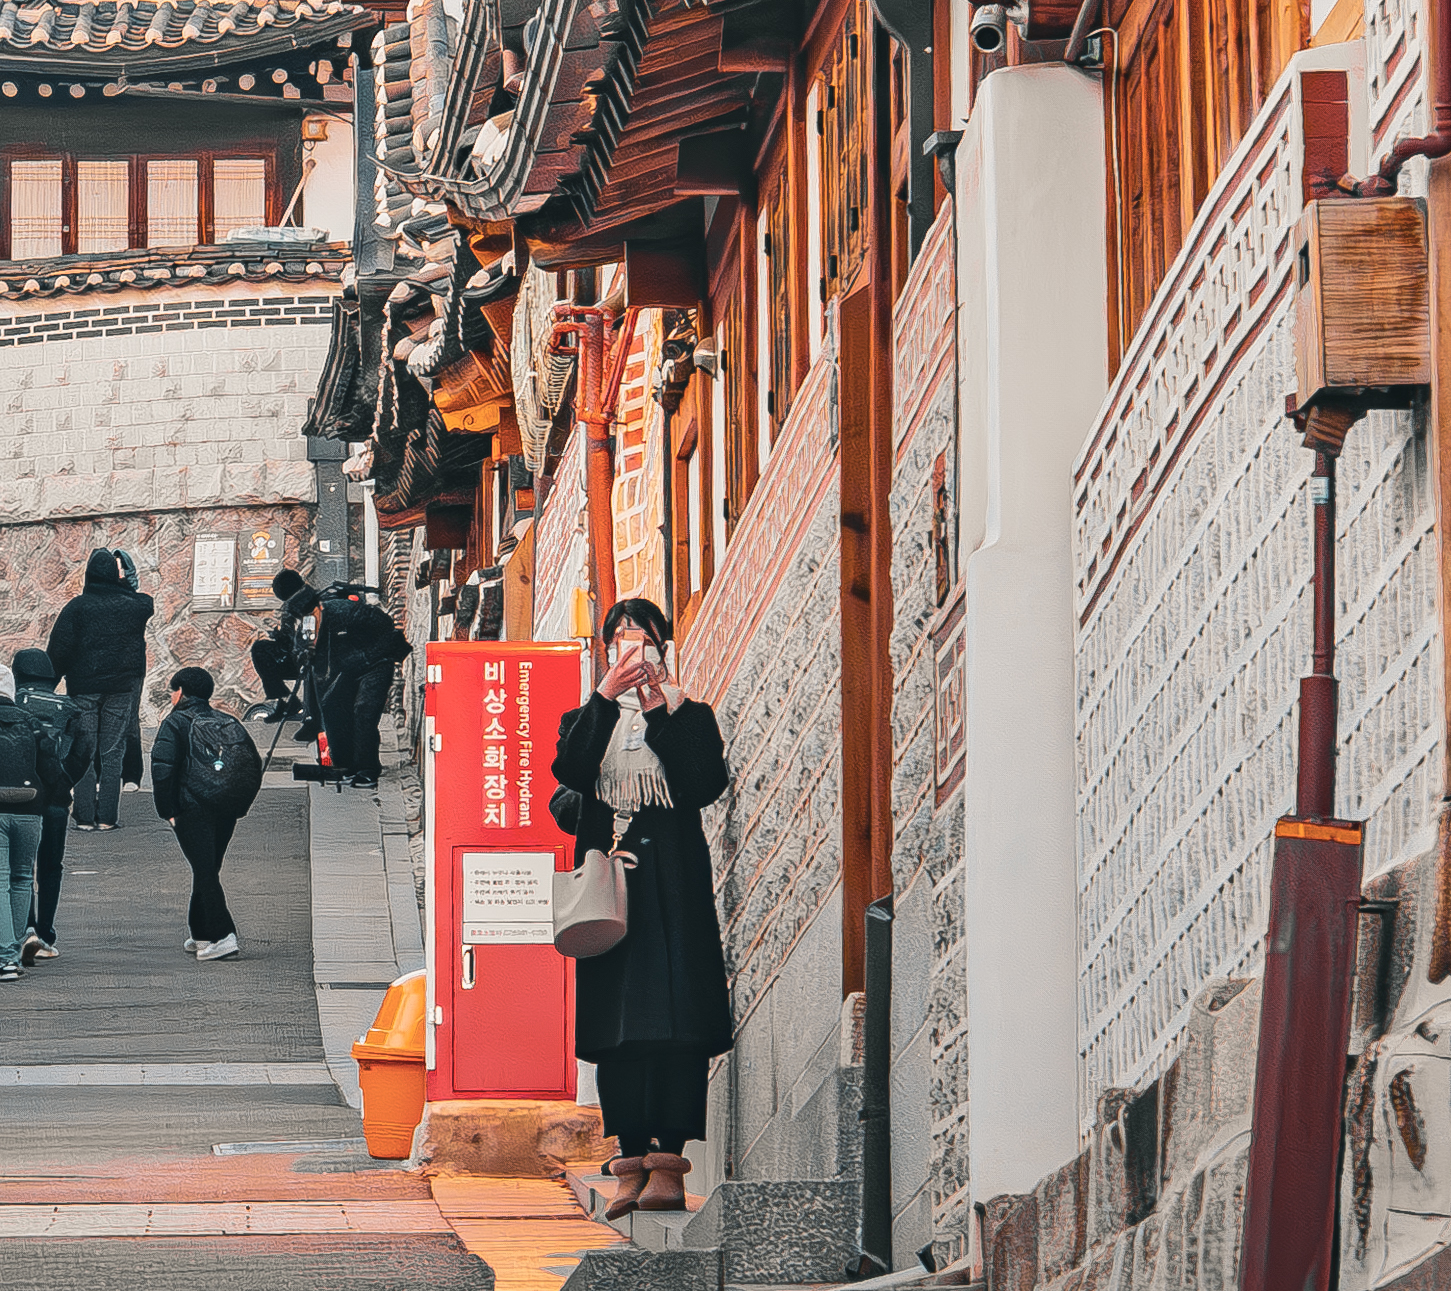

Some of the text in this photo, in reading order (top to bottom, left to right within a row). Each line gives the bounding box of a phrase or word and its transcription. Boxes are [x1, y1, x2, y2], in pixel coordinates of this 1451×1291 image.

[482, 660, 508, 829] 비상소화장치
[515, 661, 533, 827] Emergency Fire Hydrant
